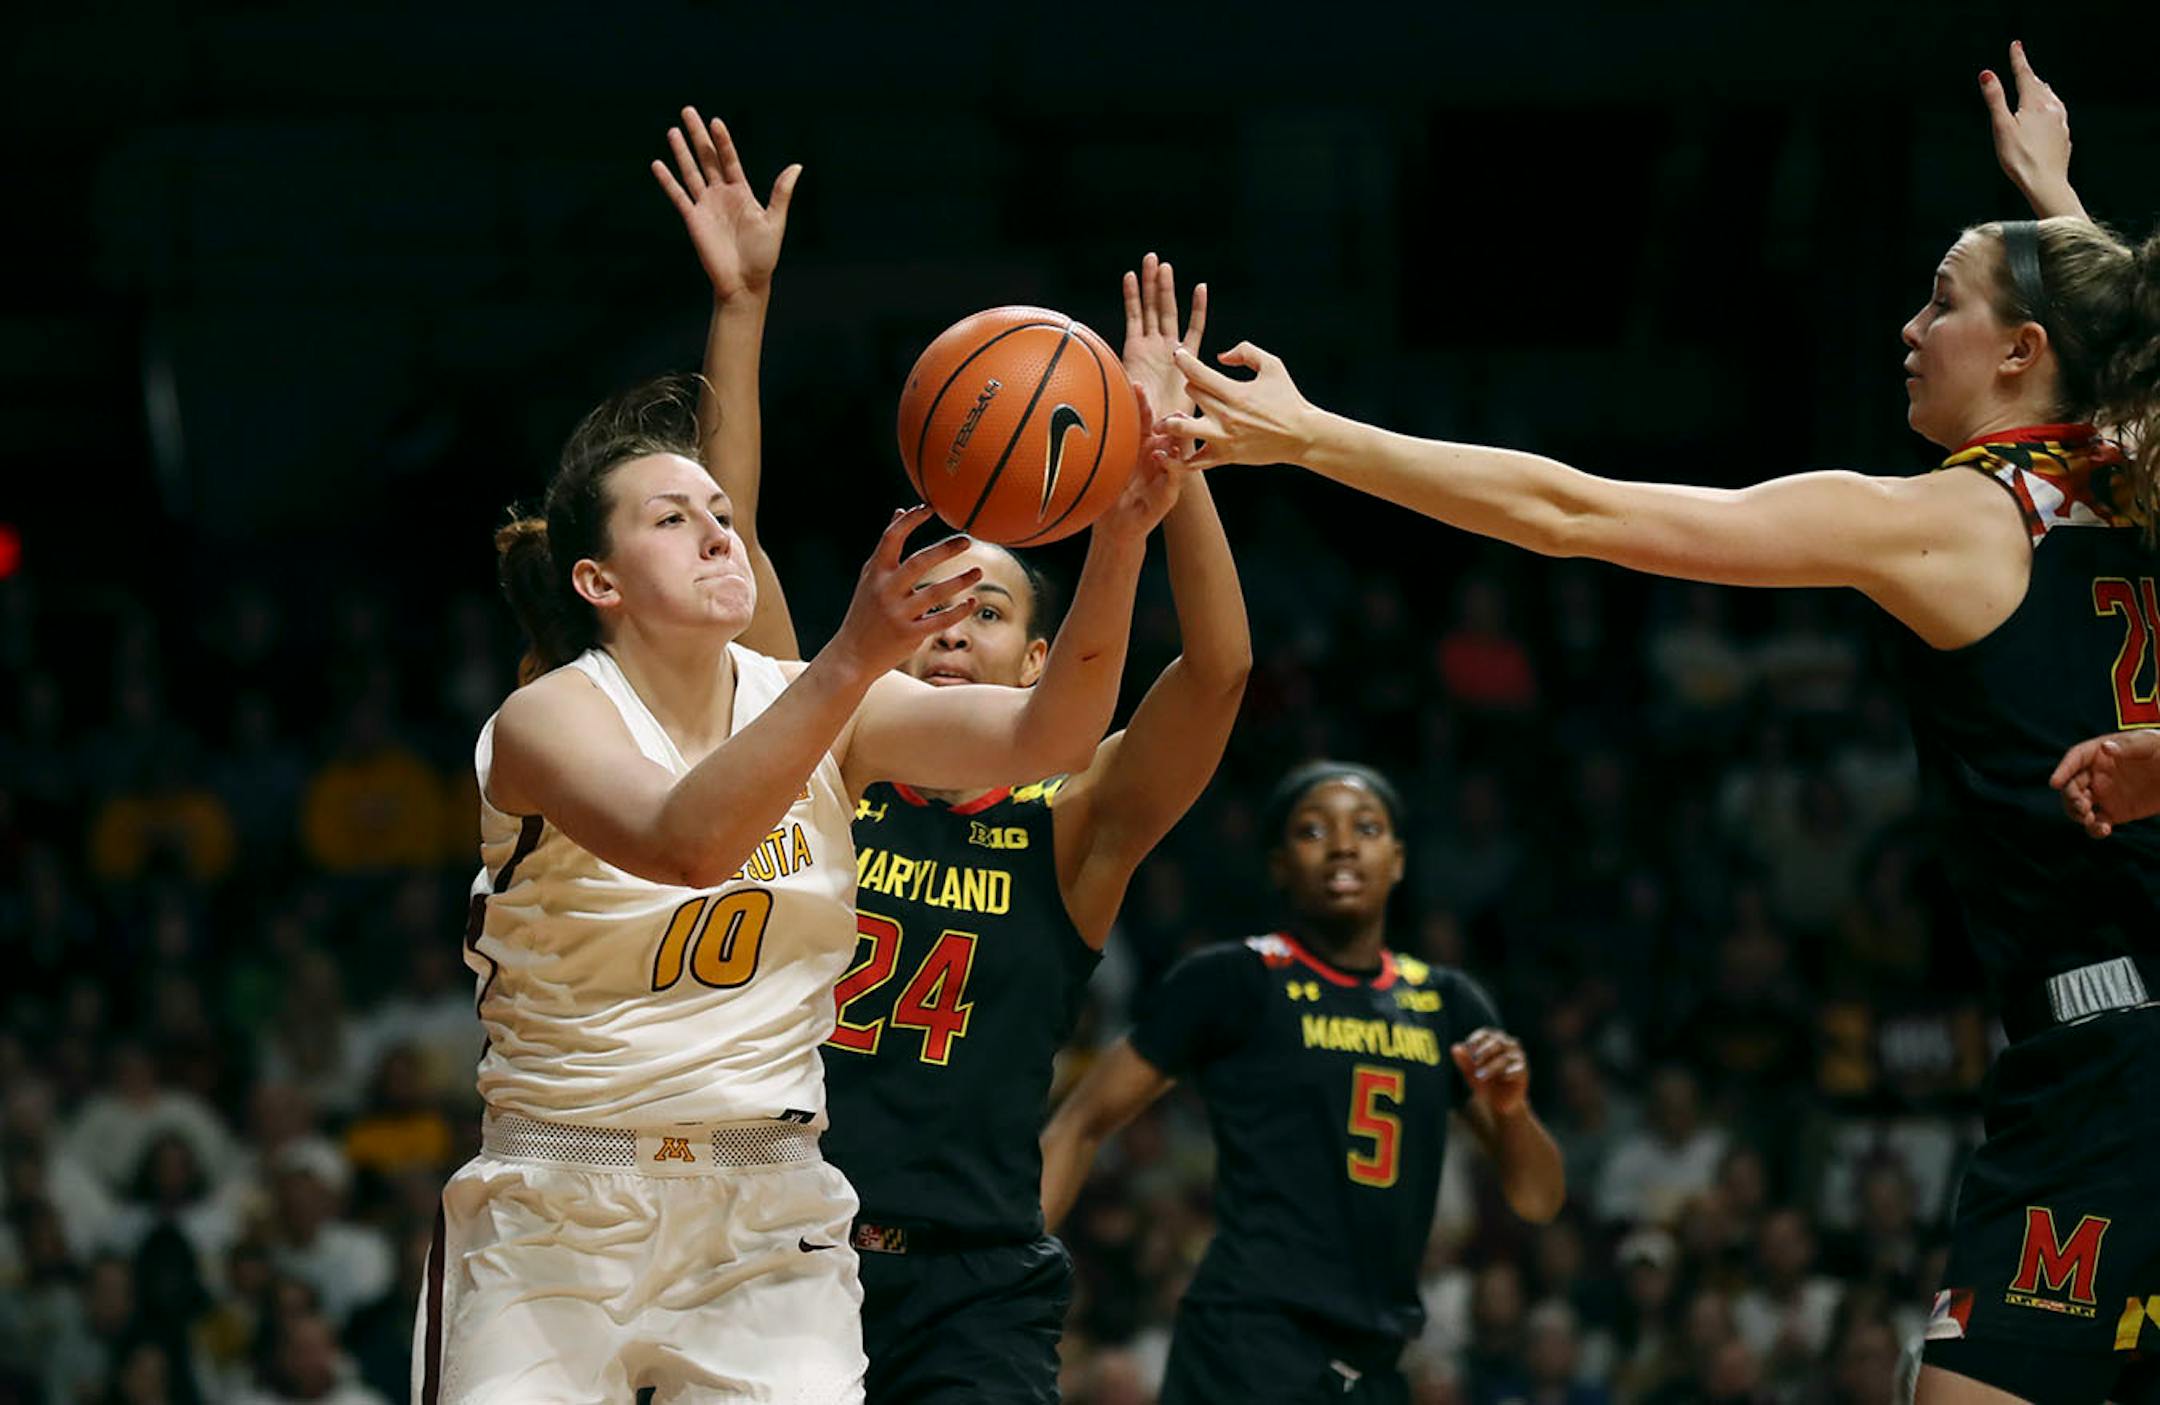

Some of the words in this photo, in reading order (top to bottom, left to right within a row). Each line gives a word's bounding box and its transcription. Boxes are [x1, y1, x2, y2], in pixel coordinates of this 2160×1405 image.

[651, 887, 774, 992] 10
[823, 909, 979, 1066] 24
[1301, 1013, 1441, 1067] MARYLAND
[654, 1137, 696, 1163] M
[1347, 1063, 1406, 1188] 5
[2008, 1205, 2112, 1305] M
